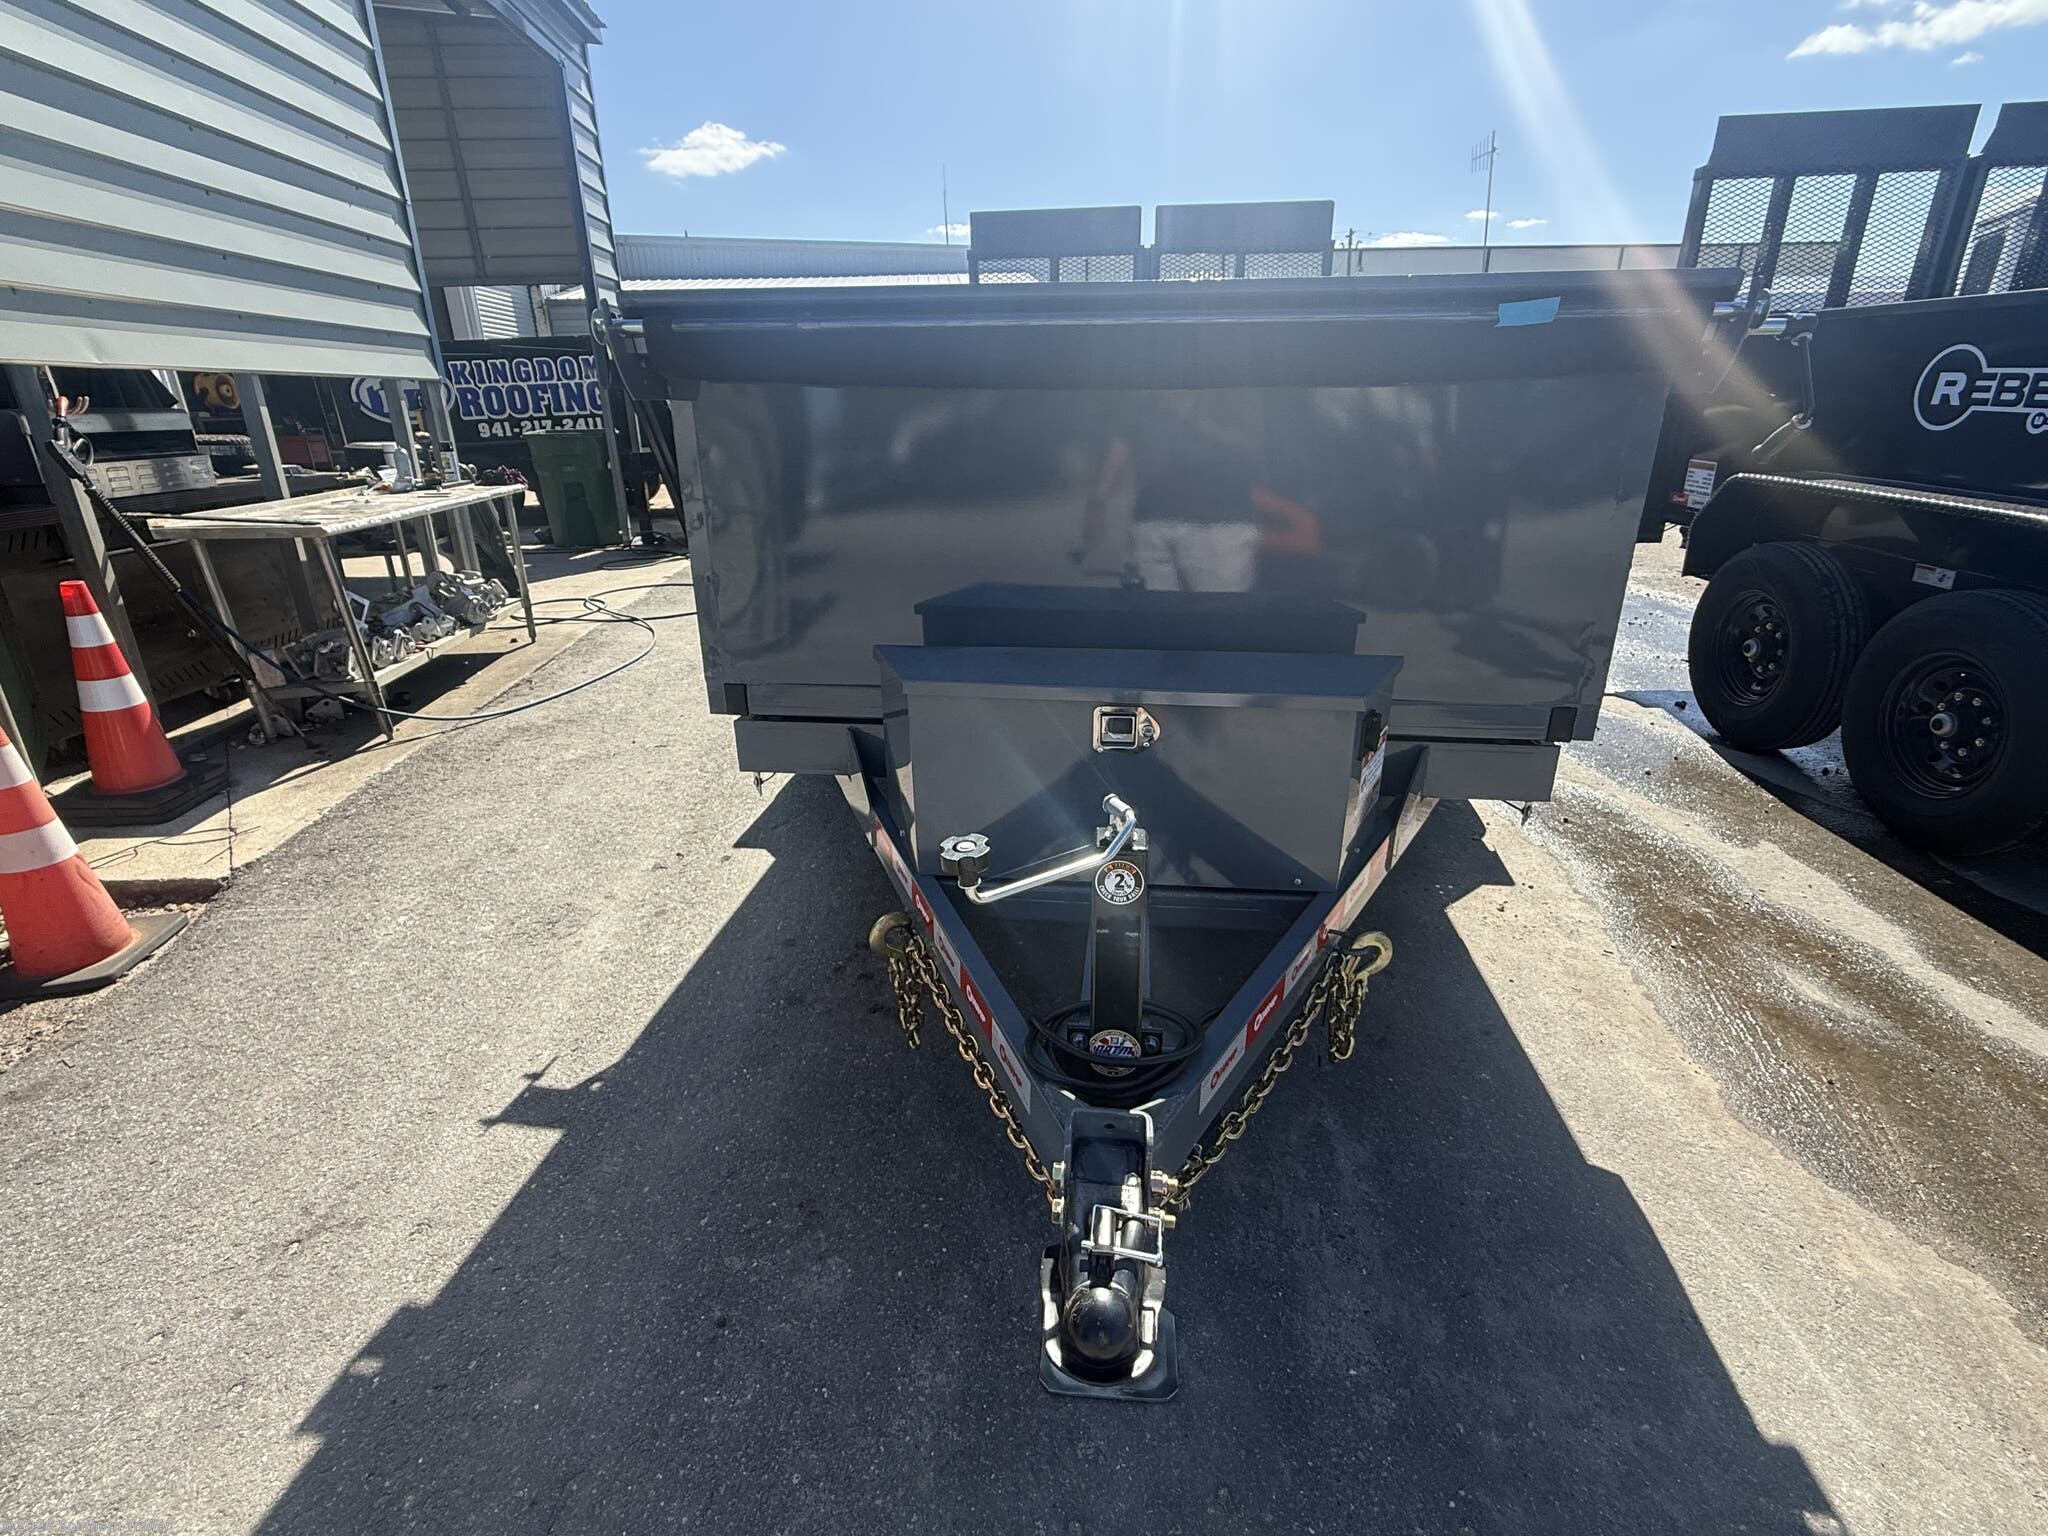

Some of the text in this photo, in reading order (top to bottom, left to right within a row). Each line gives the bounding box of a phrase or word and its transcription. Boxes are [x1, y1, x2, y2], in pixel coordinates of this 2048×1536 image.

[448, 355, 598, 386] KINGDOM
[455, 380, 603, 420] ROOFING
[1114, 873, 1125, 888] 2
